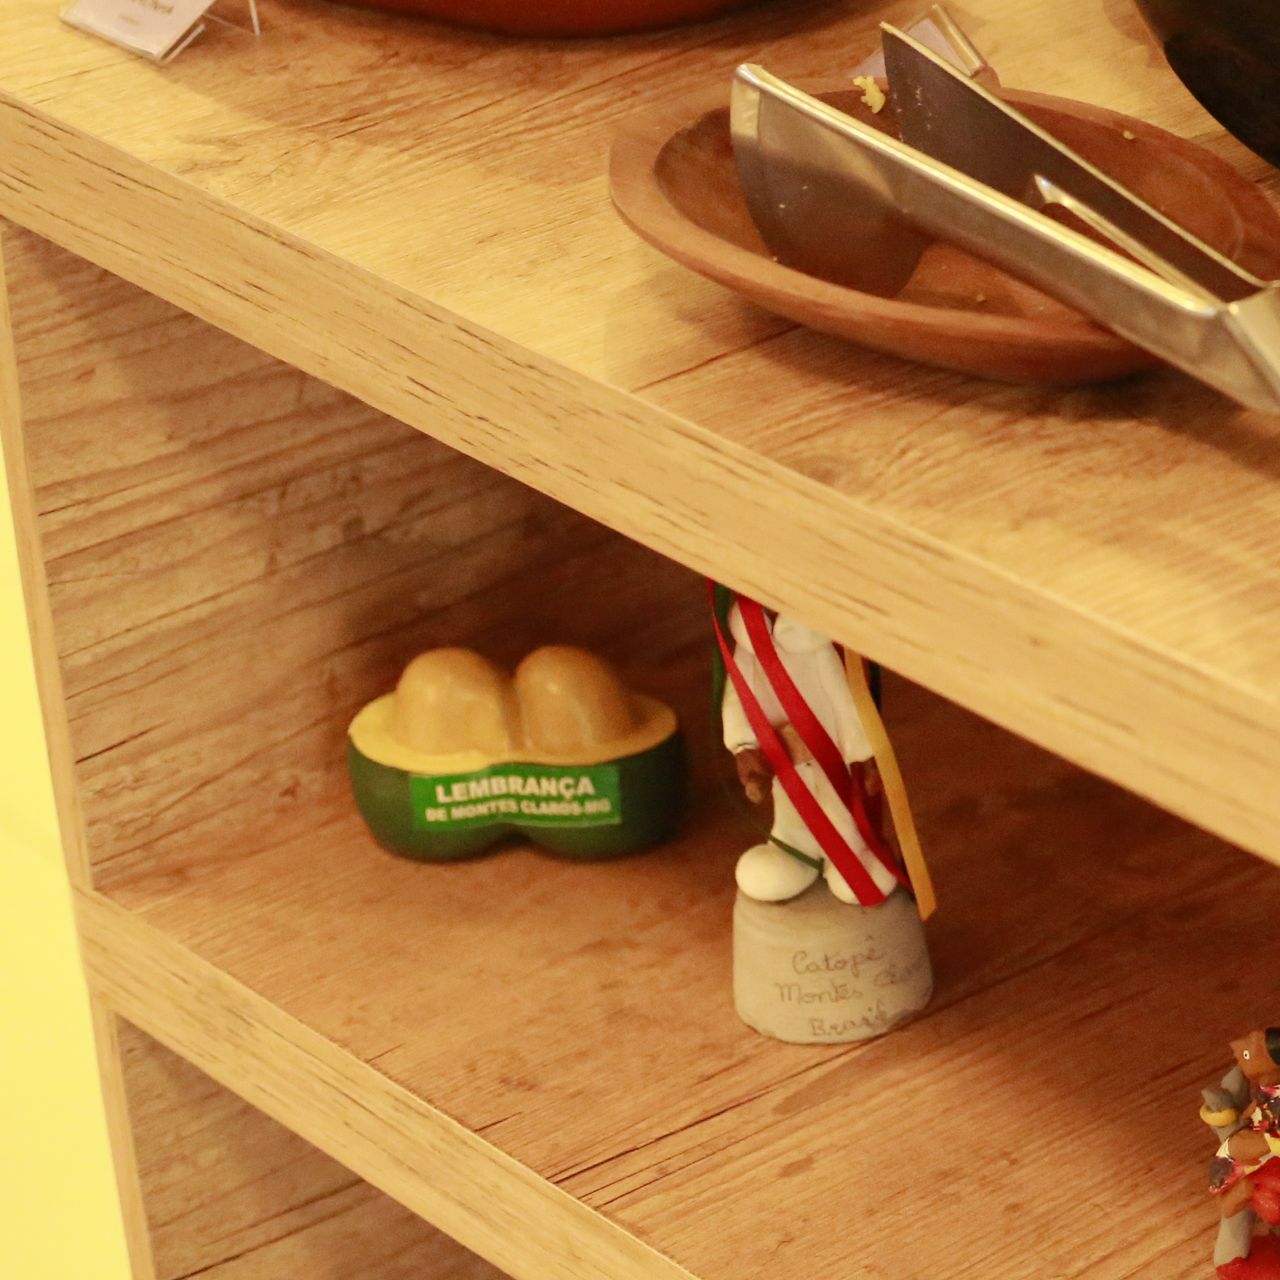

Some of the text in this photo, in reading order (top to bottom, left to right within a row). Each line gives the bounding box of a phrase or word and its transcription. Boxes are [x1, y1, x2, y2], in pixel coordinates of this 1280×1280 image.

[435, 775, 596, 804] LEMBRANÇA
[425, 807, 448, 823] DE
[450, 799, 519, 822] MONTES
[775, 976, 865, 1005] Montes
